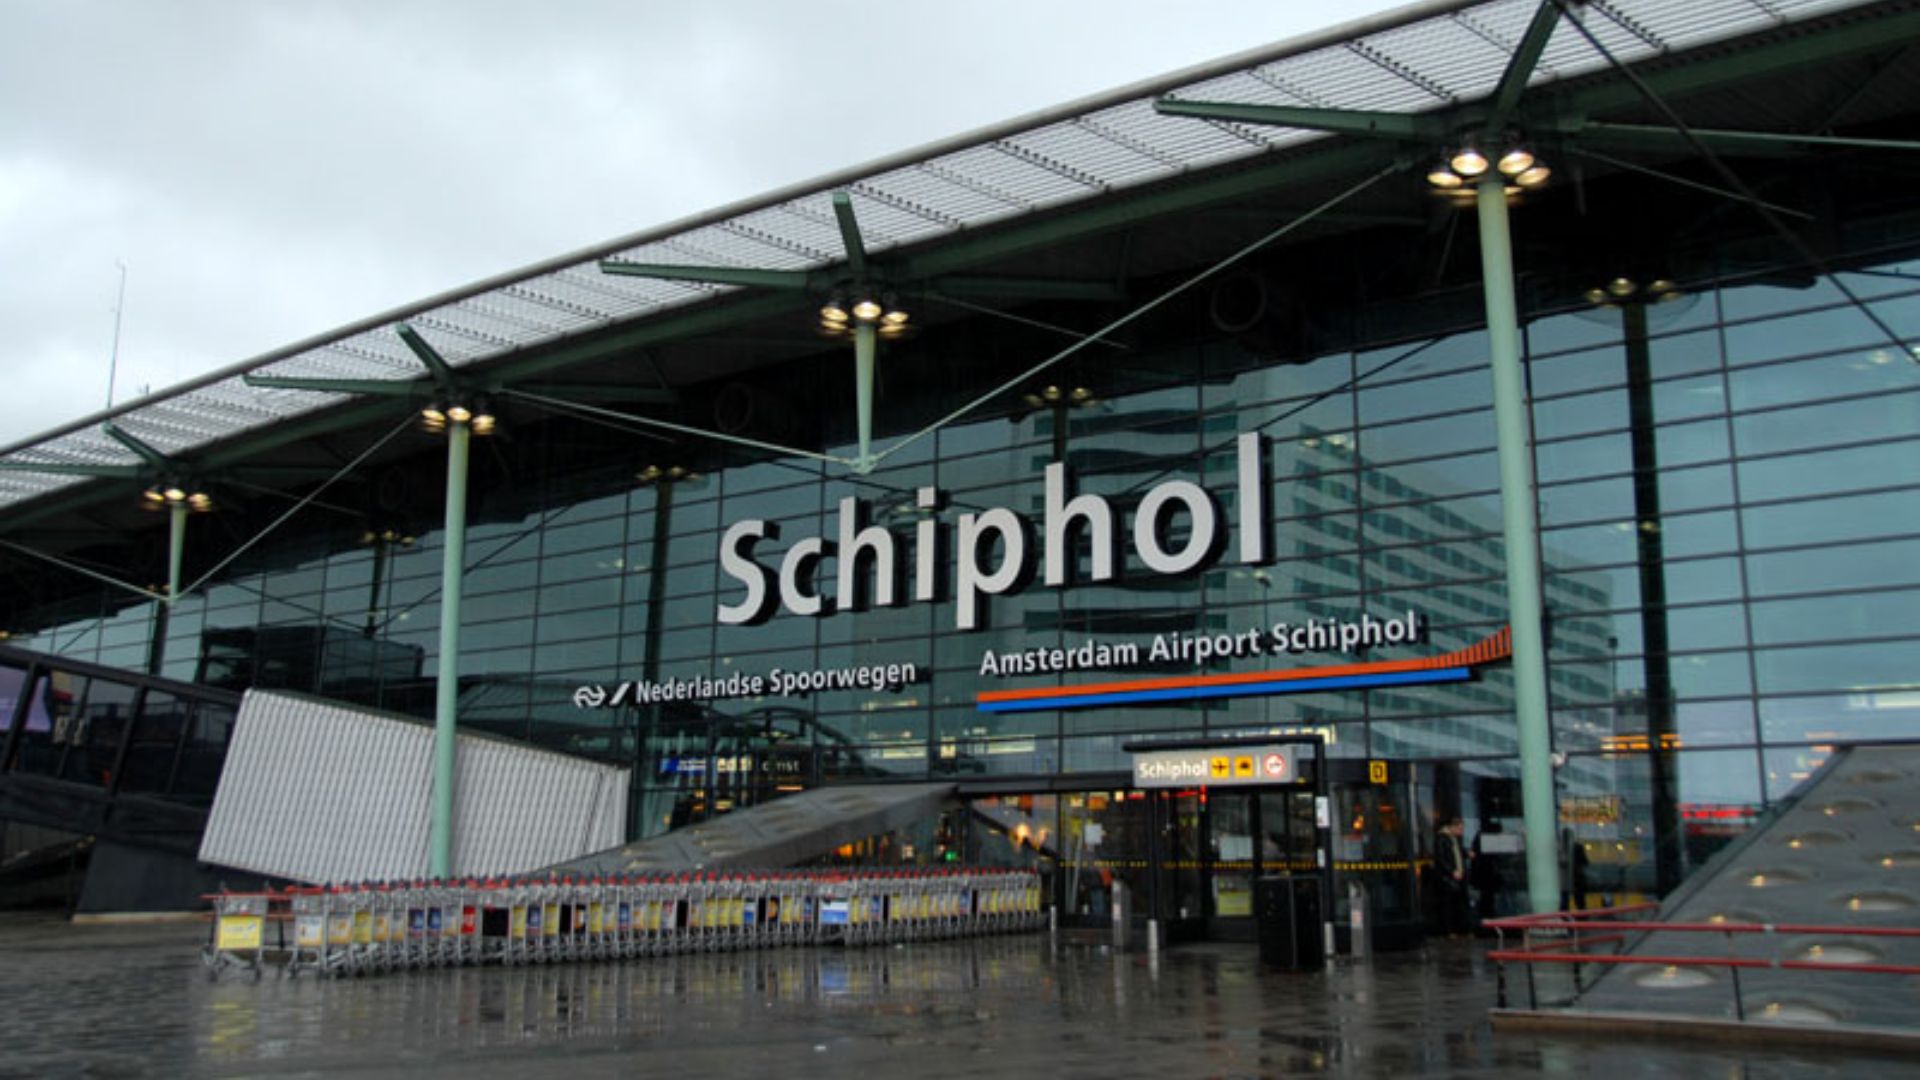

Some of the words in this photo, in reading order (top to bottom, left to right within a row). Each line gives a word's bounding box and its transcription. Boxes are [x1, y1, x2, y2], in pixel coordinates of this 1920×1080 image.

[717, 431, 1263, 630] Schiphol
[979, 639, 1138, 676] Amsterdam
[1149, 627, 1261, 667] Airport
[1272, 610, 1418, 653] Schiphol
[635, 671, 763, 704] Nederlandse
[769, 661, 916, 697] Spoorwegen
[1138, 758, 1209, 780] Schiphol
